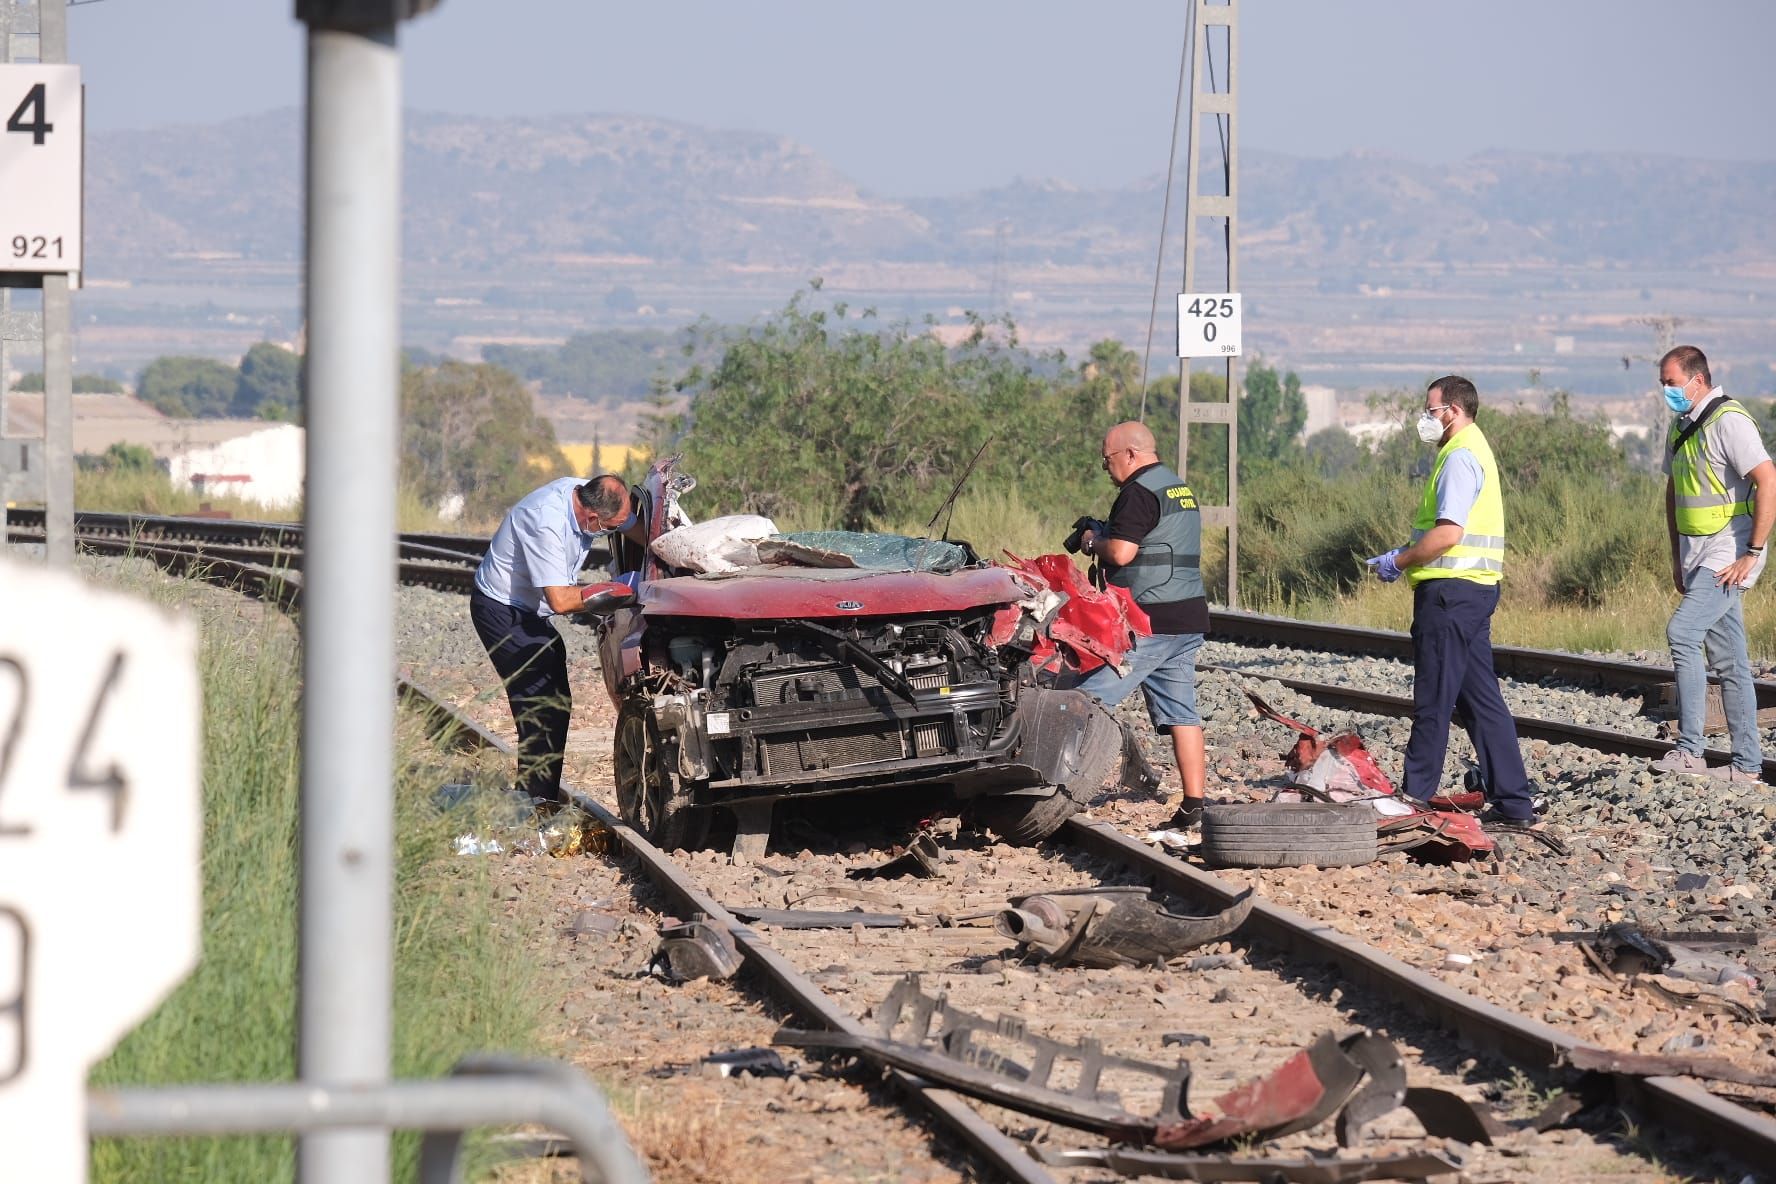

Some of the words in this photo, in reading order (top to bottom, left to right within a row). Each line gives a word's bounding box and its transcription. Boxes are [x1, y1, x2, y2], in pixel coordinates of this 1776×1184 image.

[12, 235, 63, 259] 921
[1187, 298, 1233, 318] 425
[1203, 321, 1217, 343] 0
